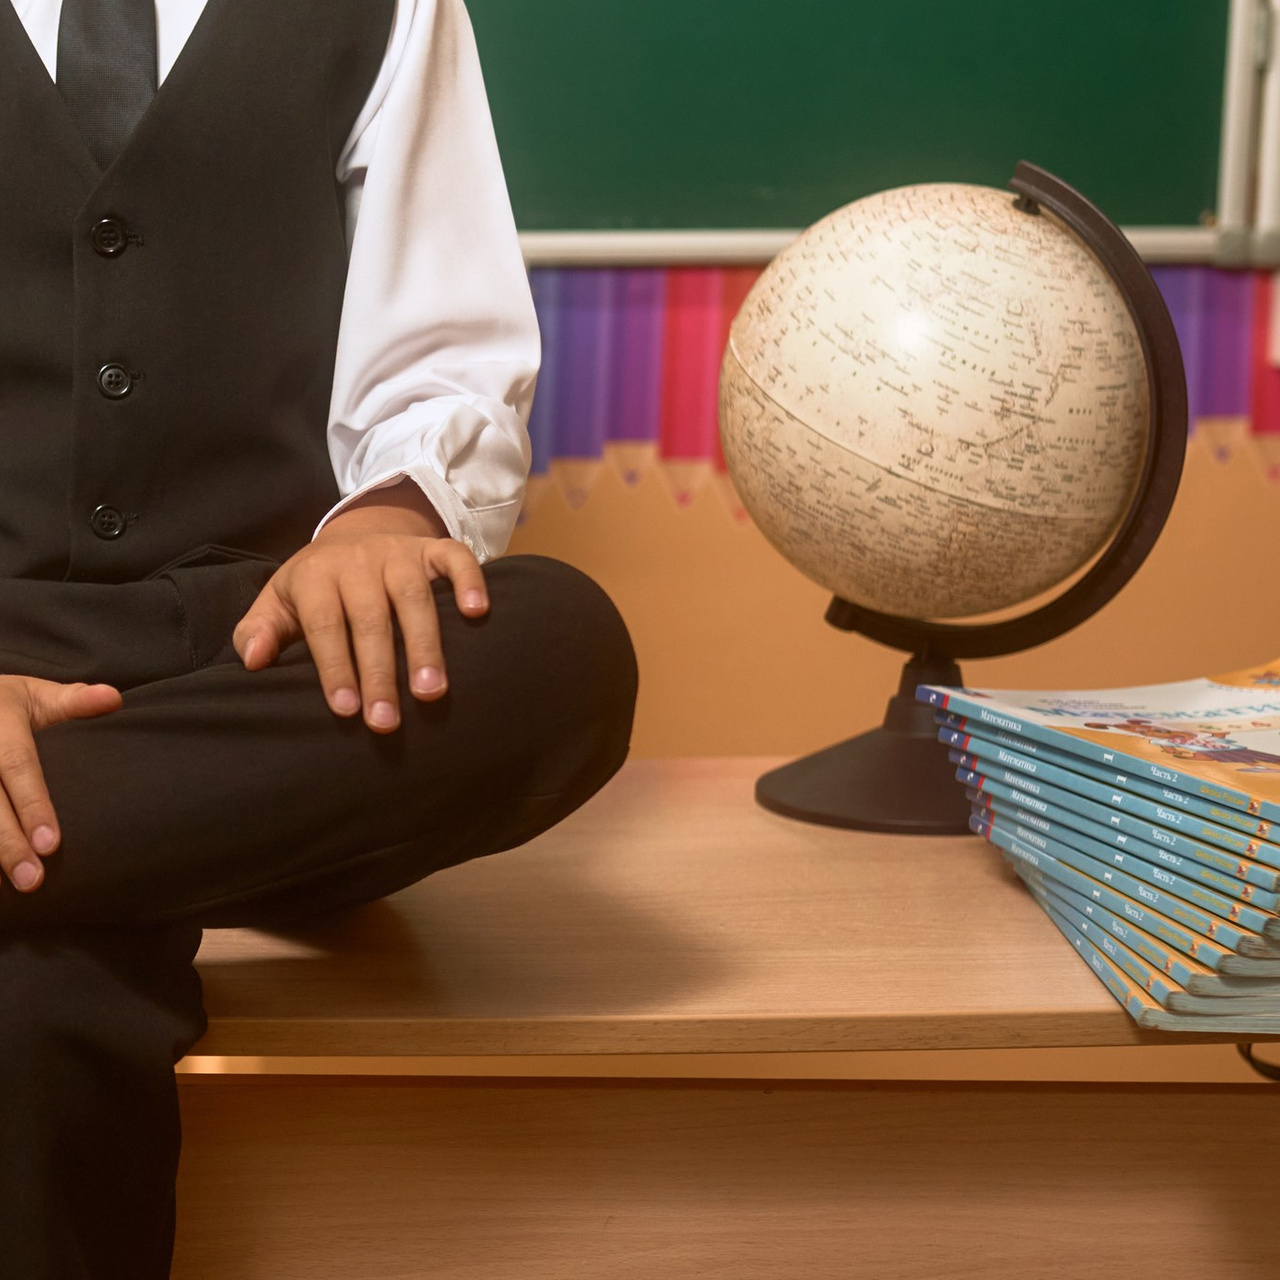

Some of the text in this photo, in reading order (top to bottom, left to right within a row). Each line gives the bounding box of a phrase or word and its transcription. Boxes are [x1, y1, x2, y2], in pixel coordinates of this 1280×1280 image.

[980, 709, 1022, 733] Математика
[1150, 765, 1172, 780] Часть
[1172, 773, 1179, 782] 2
[998, 750, 1037, 773] Математика
[1156, 807, 1176, 822] Часть
[1151, 829, 1170, 844] Часть
[1158, 849, 1176, 864] Часть
